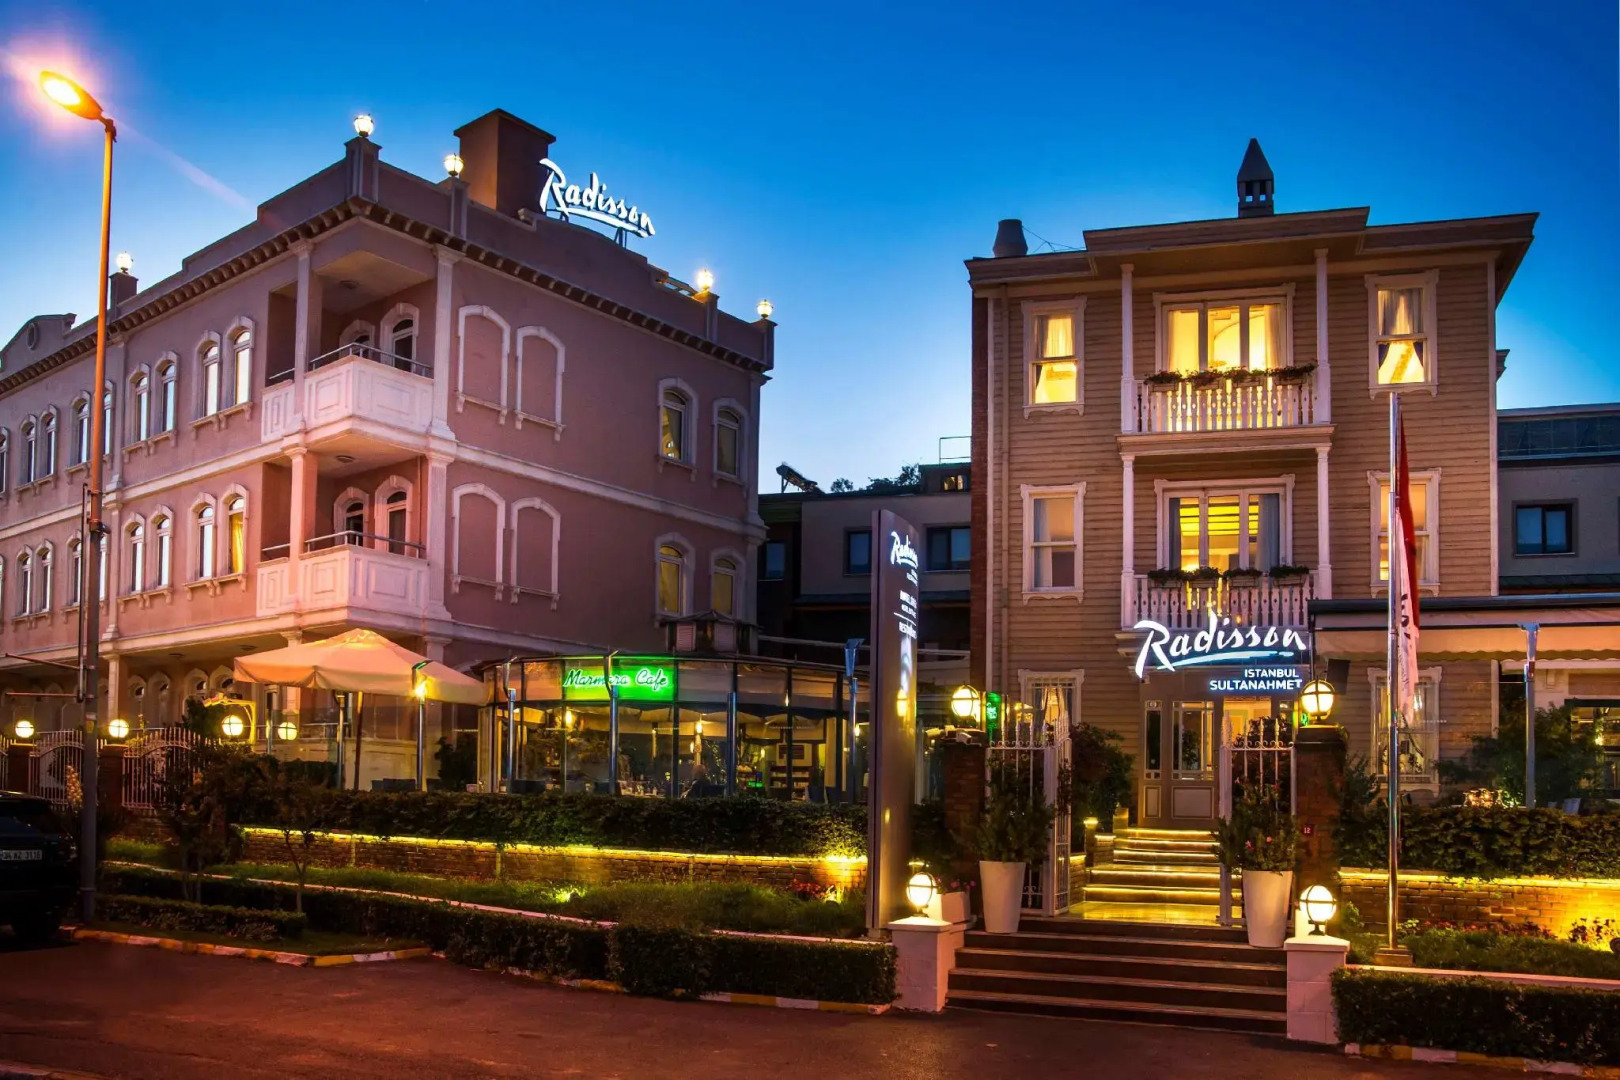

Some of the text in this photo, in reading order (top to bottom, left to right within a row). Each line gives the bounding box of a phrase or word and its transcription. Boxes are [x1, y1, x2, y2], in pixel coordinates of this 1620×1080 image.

[539, 158, 656, 237] Radisson
[1134, 606, 1307, 679] Radisson
[636, 668, 669, 691] Cafe
[1209, 678, 1303, 691] SULTANAHMET
[1244, 668, 1300, 679] ISTANBUL
